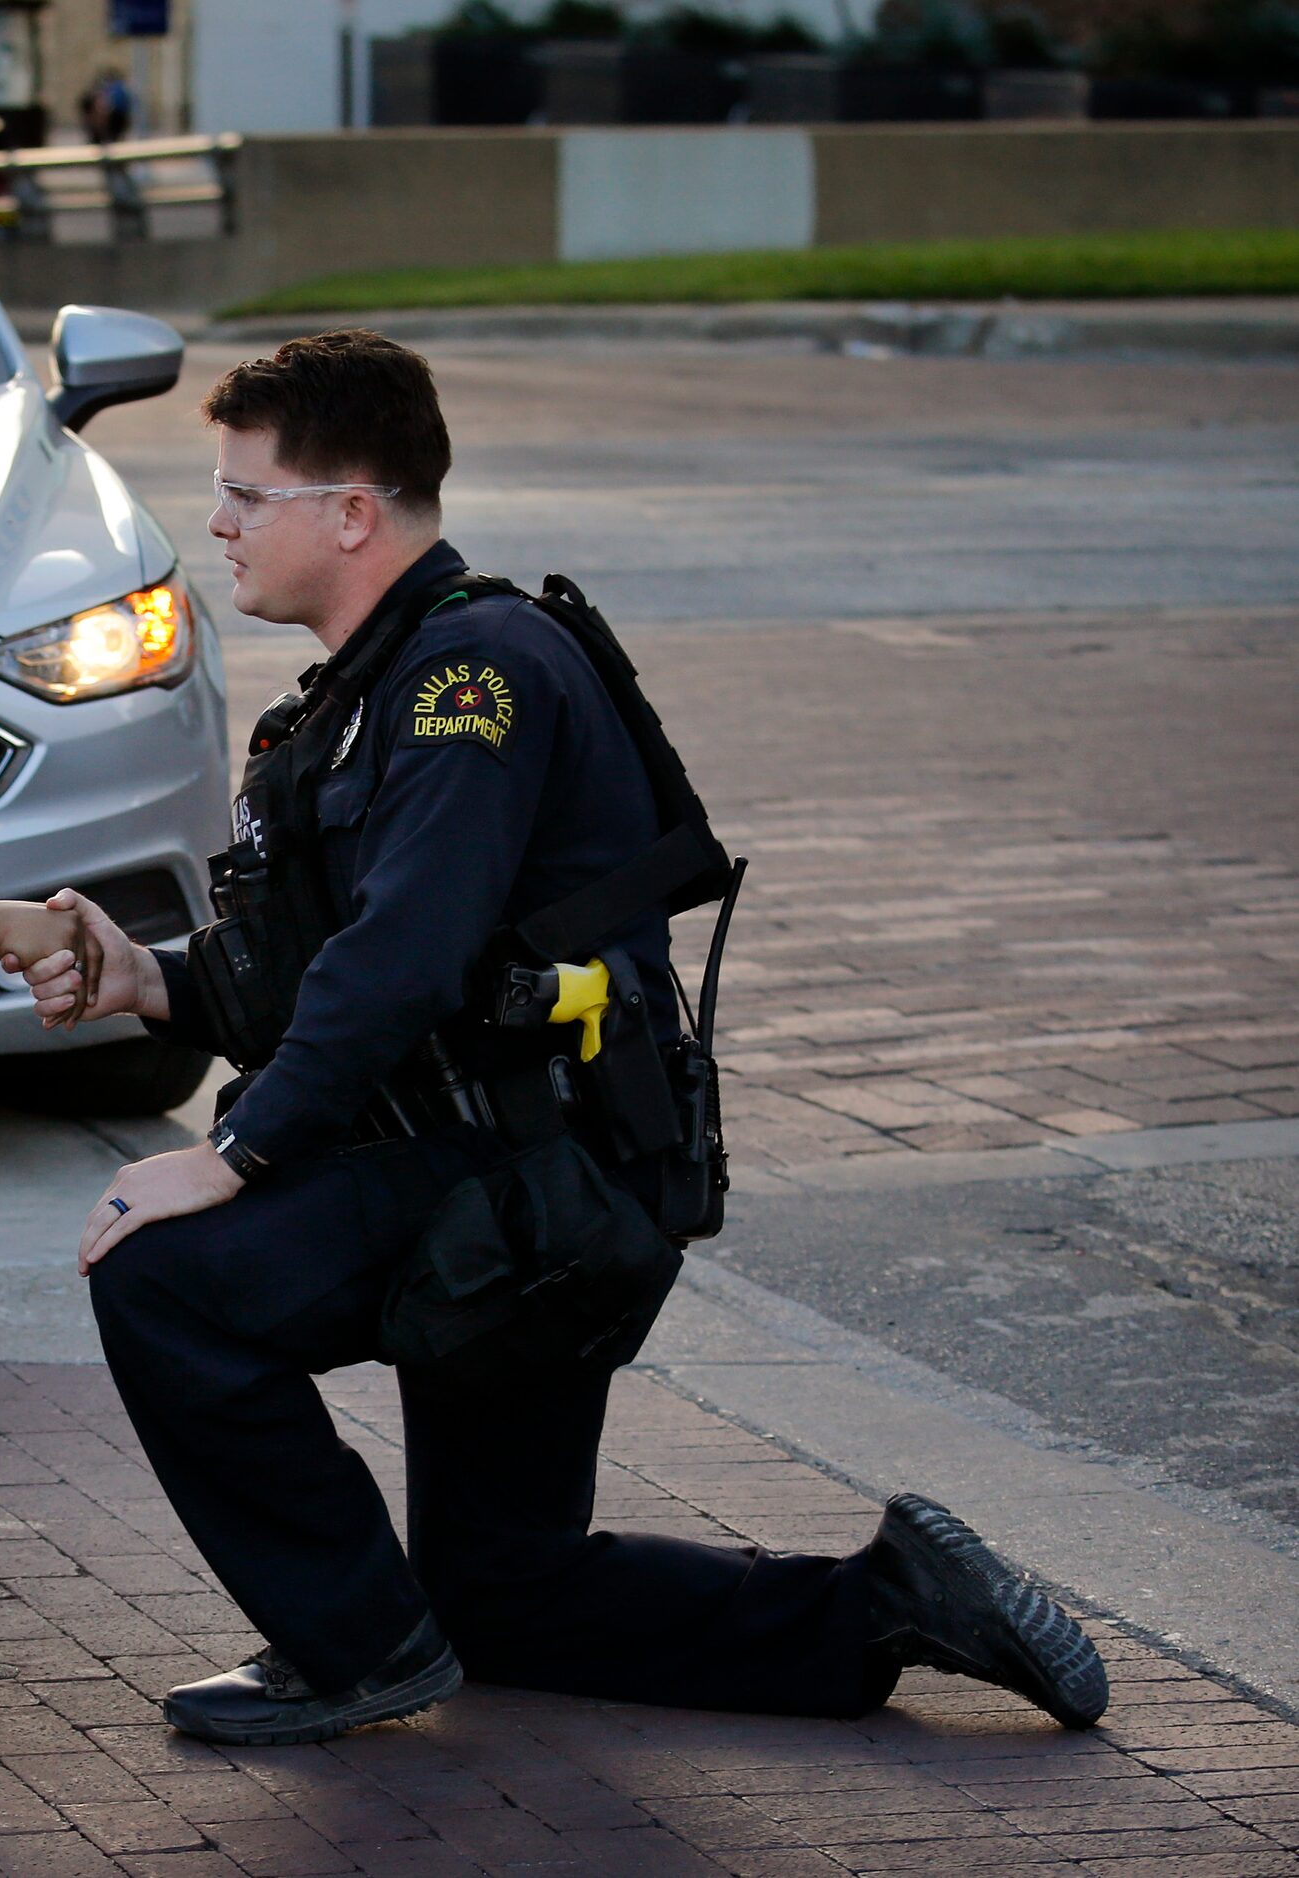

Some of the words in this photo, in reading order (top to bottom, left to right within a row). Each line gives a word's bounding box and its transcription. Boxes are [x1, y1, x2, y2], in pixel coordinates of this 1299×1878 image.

[413, 664, 471, 713] DALLAS
[477, 666, 513, 730] POLICE
[413, 714, 507, 748] DEPARTMENT
